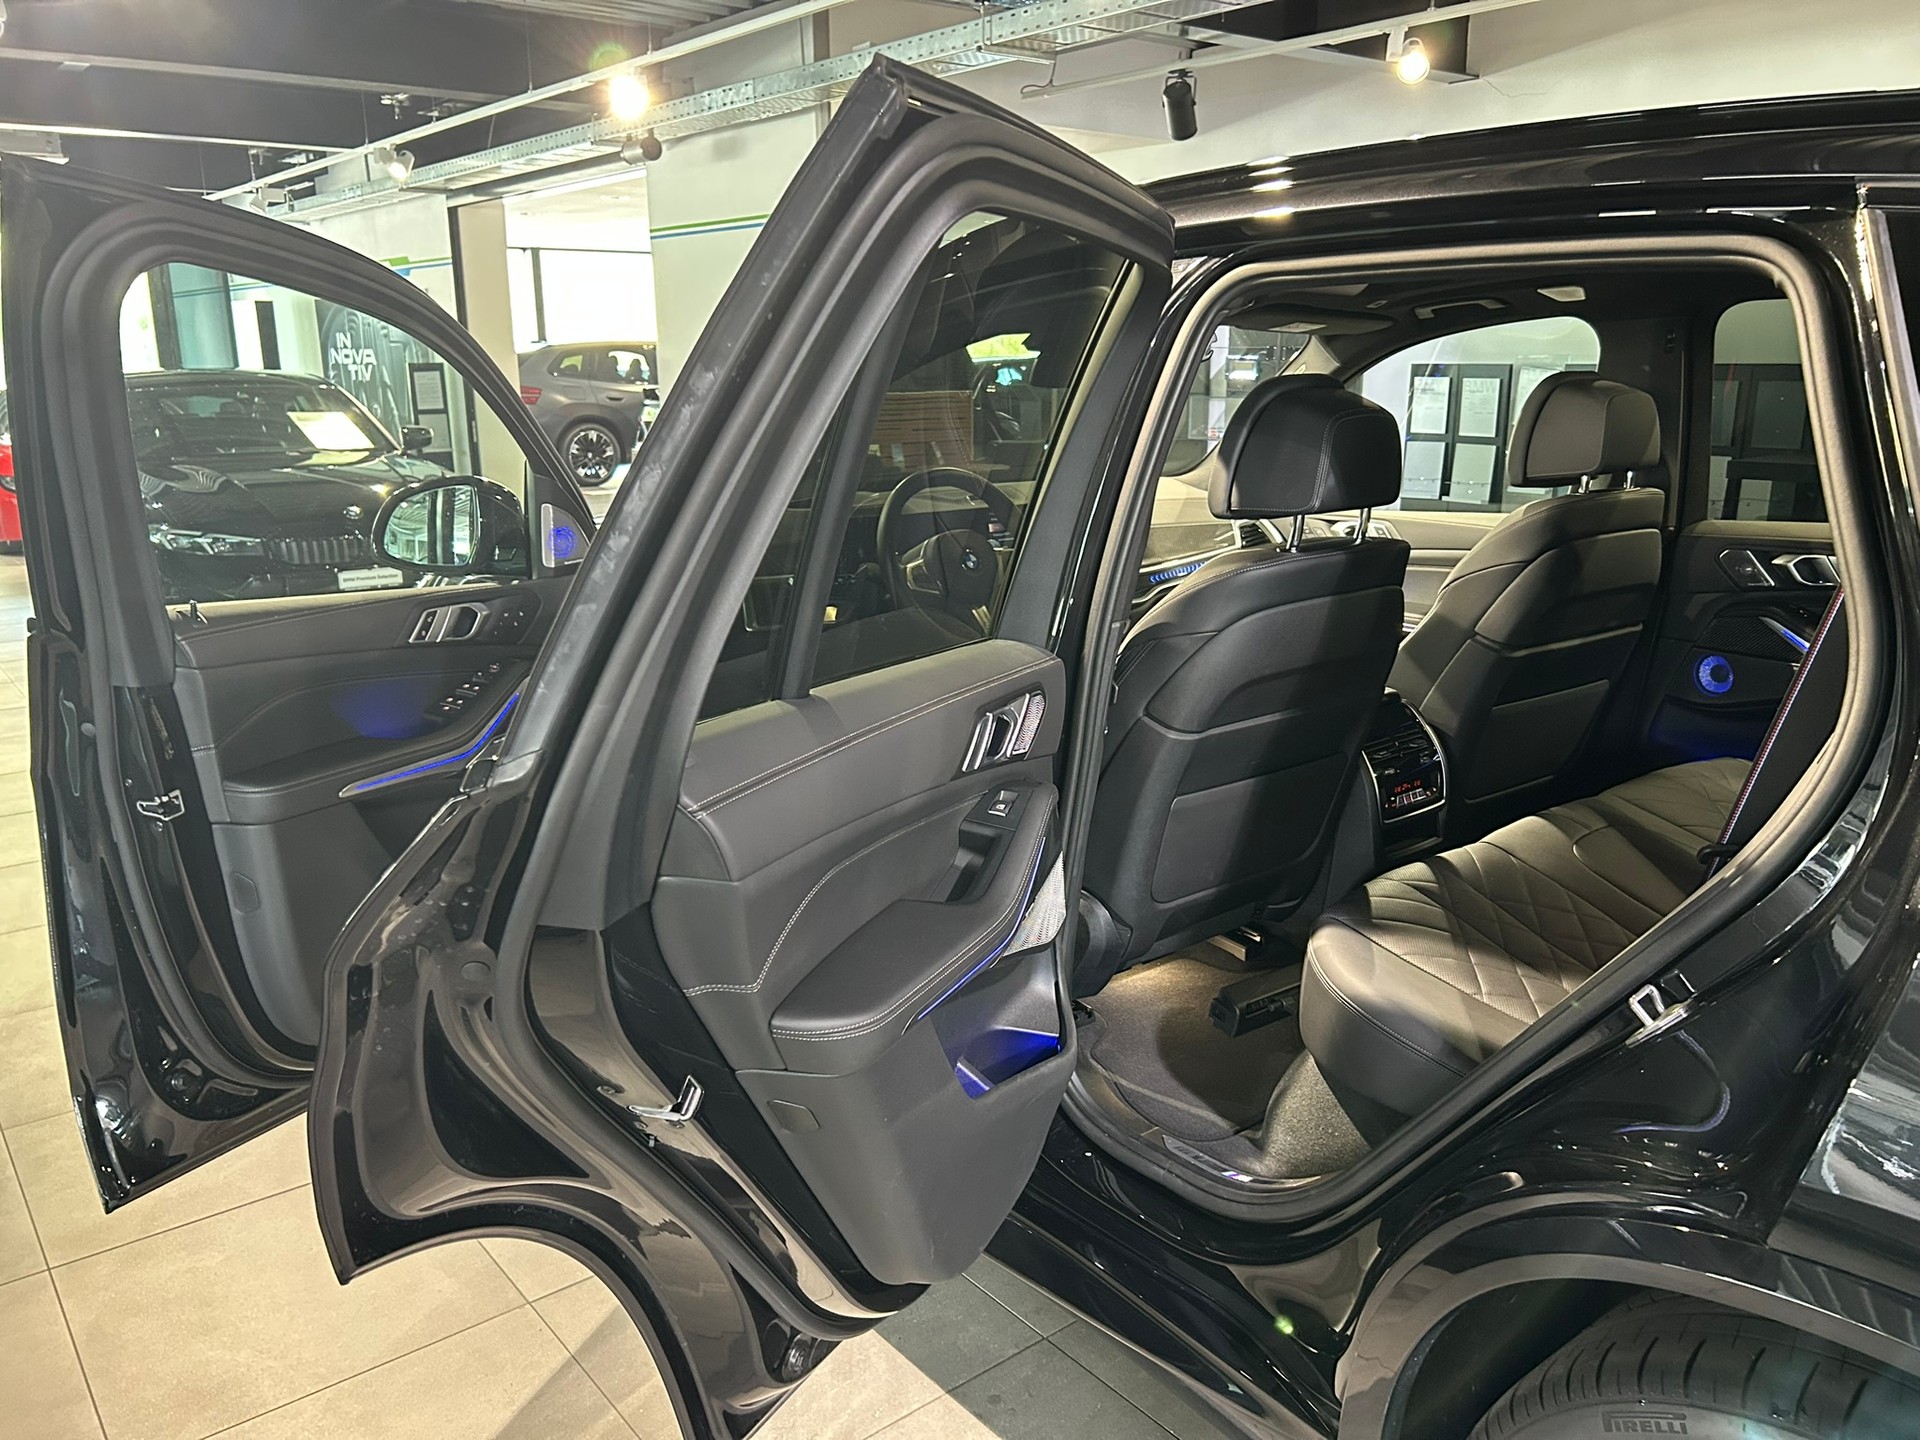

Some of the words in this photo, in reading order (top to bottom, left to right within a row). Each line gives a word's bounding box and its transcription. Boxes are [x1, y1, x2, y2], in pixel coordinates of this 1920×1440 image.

[336, 331, 351, 349] IN
[330, 347, 377, 366] NOVA
[348, 364, 373, 382] TIV
[1602, 1410, 1688, 1435] PIRELLI
